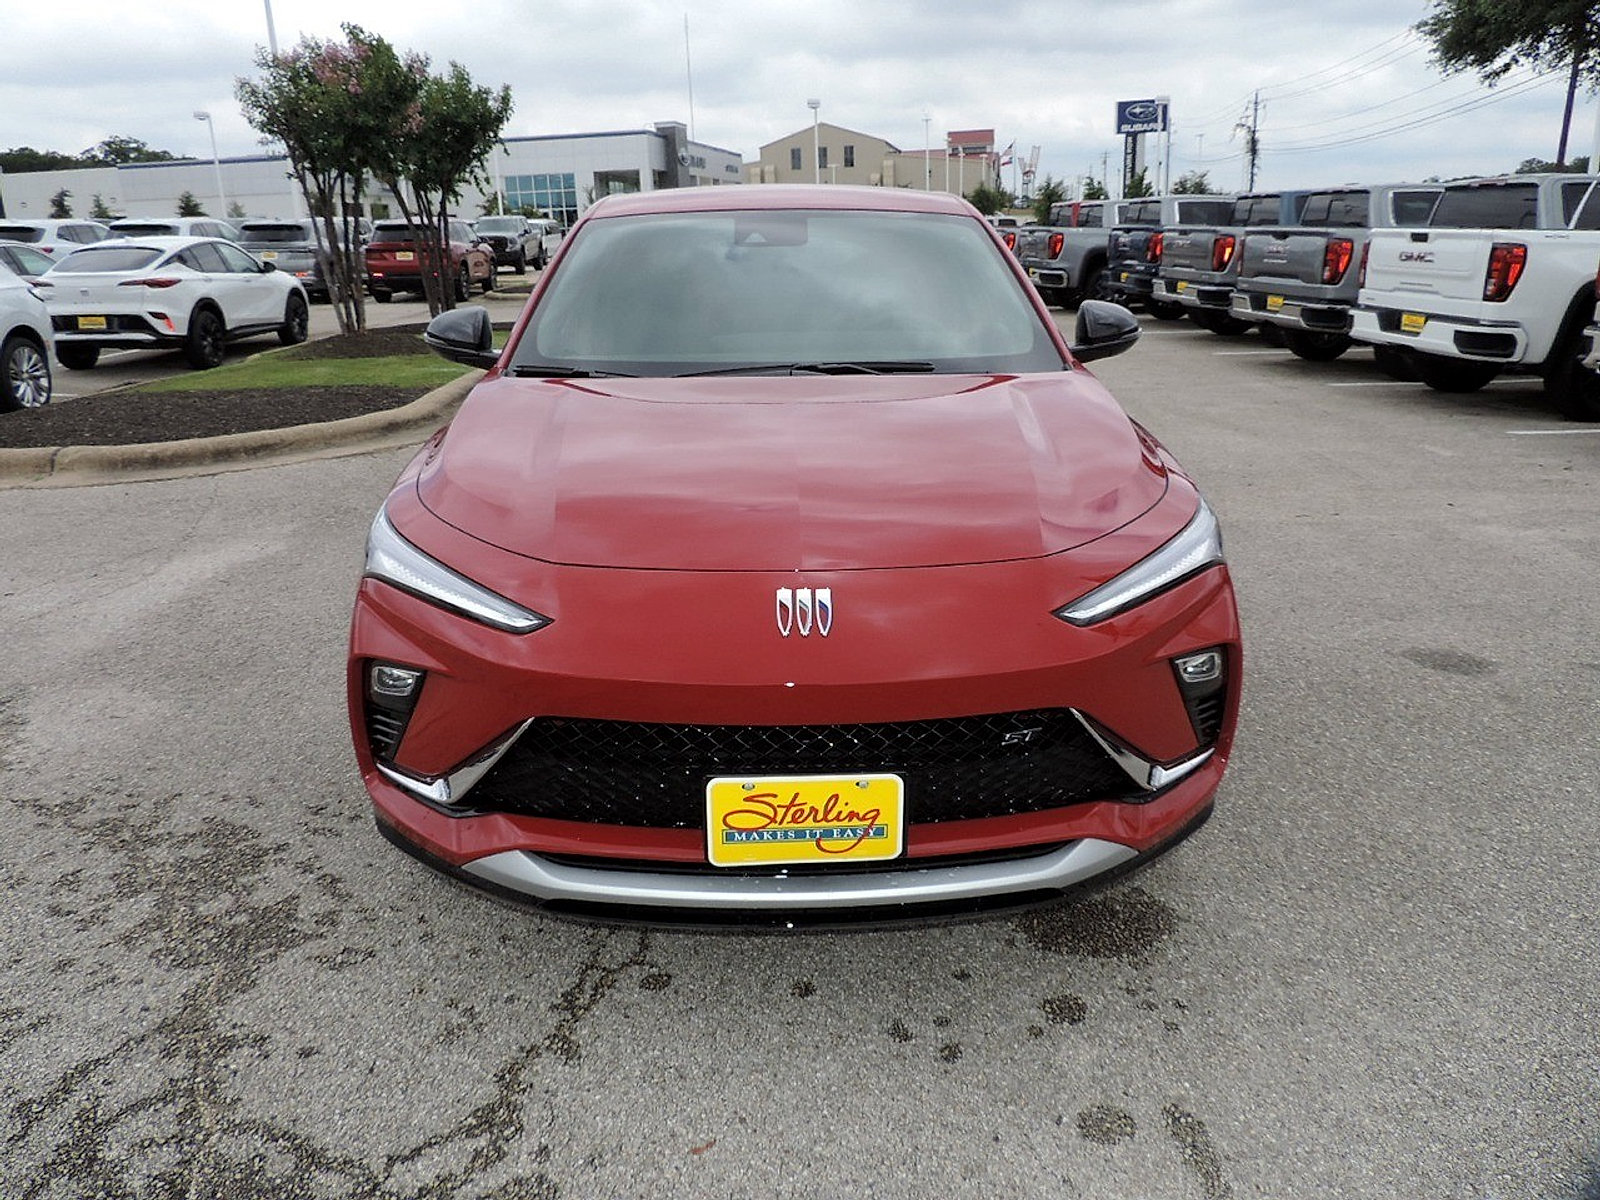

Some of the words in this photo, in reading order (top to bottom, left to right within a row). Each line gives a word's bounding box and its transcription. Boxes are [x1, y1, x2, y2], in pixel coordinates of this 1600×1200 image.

[1399, 251, 1434, 263] GMC
[722, 792, 881, 854] Sterling
[733, 830, 796, 841] MAKES
[805, 828, 824, 840] IT
[832, 826, 877, 839] EASY
